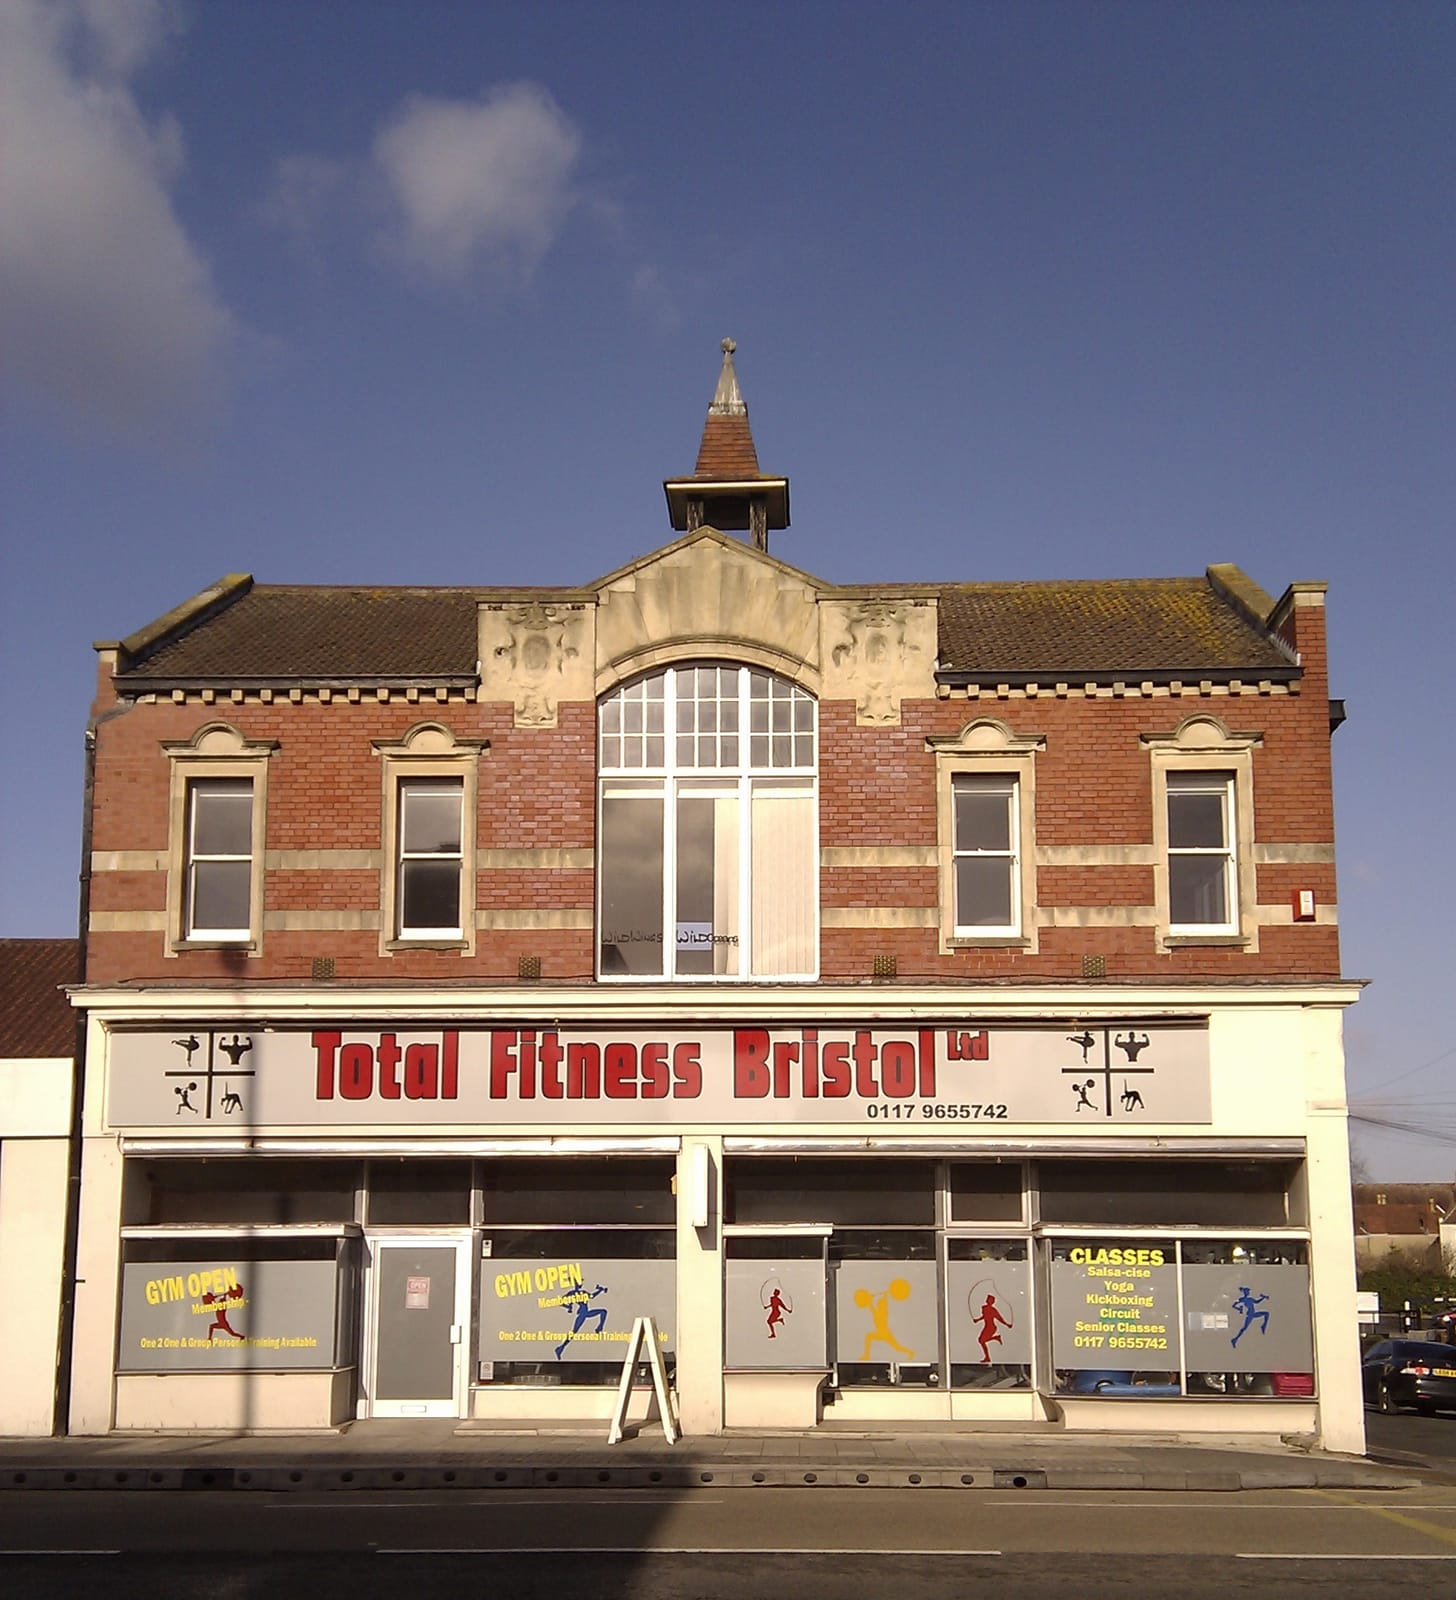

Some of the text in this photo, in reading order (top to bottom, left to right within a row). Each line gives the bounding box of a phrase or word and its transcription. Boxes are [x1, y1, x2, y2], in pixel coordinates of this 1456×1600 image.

[312, 1028, 989, 1100] Total Fitness Bristol Ltd
[866, 1104, 1008, 1119] 0117 9655742
[1070, 1248, 1165, 1267] CLASSES
[1087, 1266, 1151, 1278] Salsa-cise
[145, 1267, 238, 1305] GYM OPEN
[495, 1263, 583, 1298] GYM OPEN
[1104, 1281, 1135, 1293] Yoga
[538, 1292, 589, 1309] Membership
[1086, 1294, 1153, 1307] Kickboxing
[1100, 1308, 1141, 1319] Circuit
[1075, 1321, 1166, 1334] Senior Classes
[157, 1337, 164, 1348] 2
[515, 1331, 520, 1341] 2
[1074, 1336, 1167, 1350] 0117 9655742
